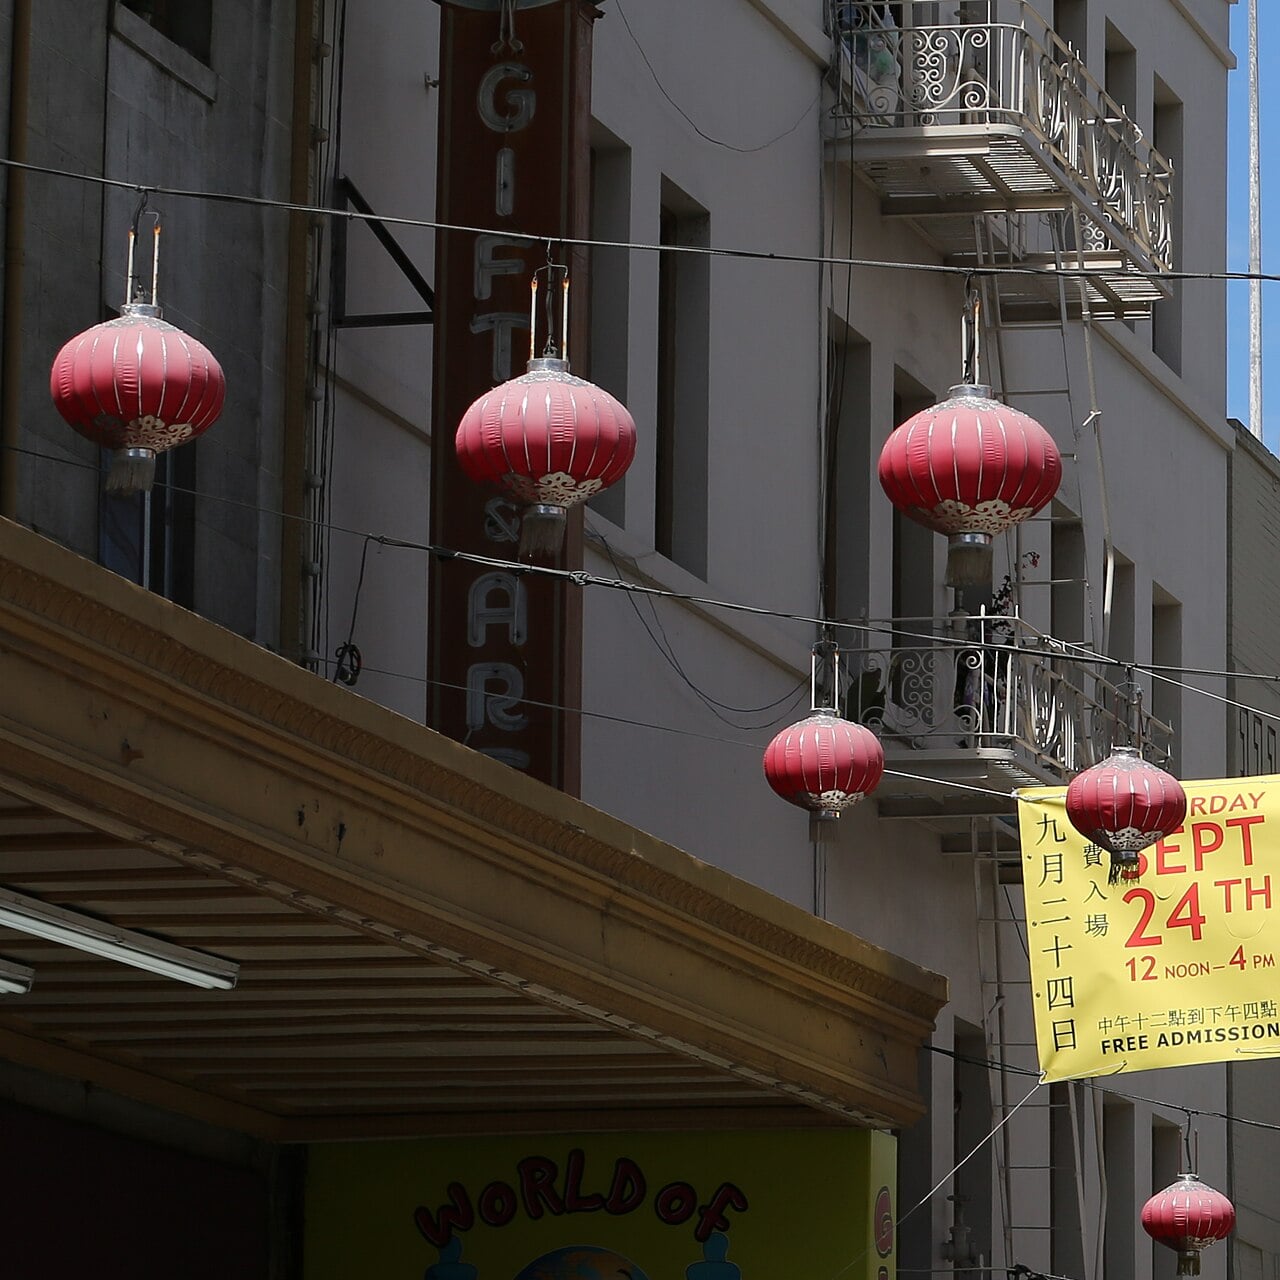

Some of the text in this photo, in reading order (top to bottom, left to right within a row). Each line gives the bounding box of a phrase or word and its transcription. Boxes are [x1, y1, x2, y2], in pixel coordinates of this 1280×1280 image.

[470, 62, 537, 383] GIFT
[465, 573, 531, 768] AR
[1189, 791, 1266, 817] RDAY
[1036, 811, 1078, 1053] 九月二十四日
[1082, 842, 1110, 938] 費入場
[1124, 953, 1276, 982] 12 PM
[1101, 1034, 1150, 1055] FREE
